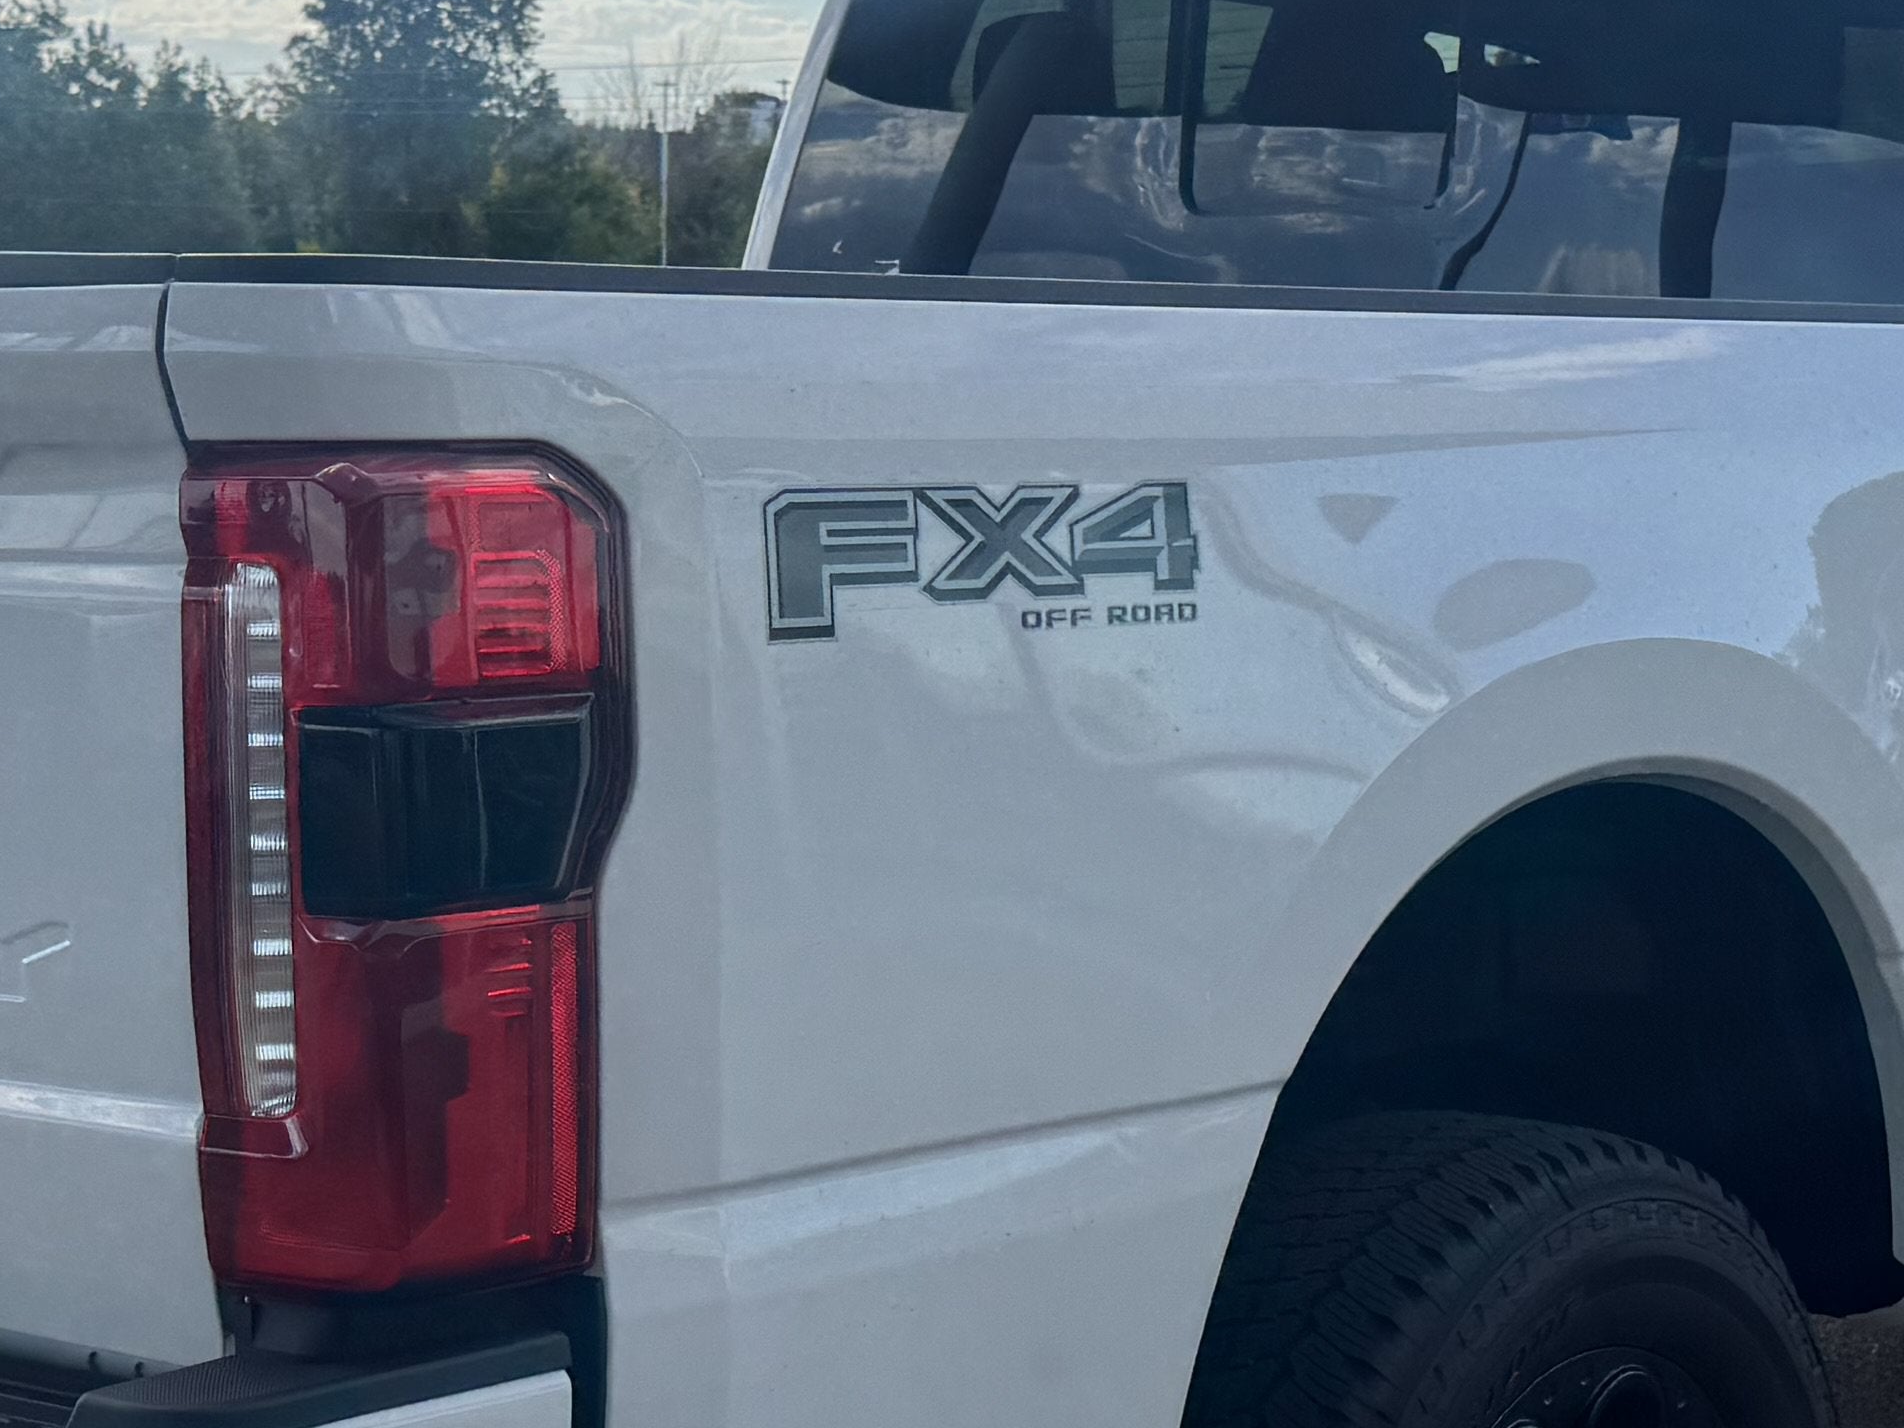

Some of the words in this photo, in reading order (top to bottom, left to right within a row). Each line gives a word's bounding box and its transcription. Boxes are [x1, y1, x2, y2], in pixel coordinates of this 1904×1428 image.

[763, 480, 1200, 643] FX4
[1021, 608, 1092, 630] OFF
[1107, 603, 1197, 626] ROAD
